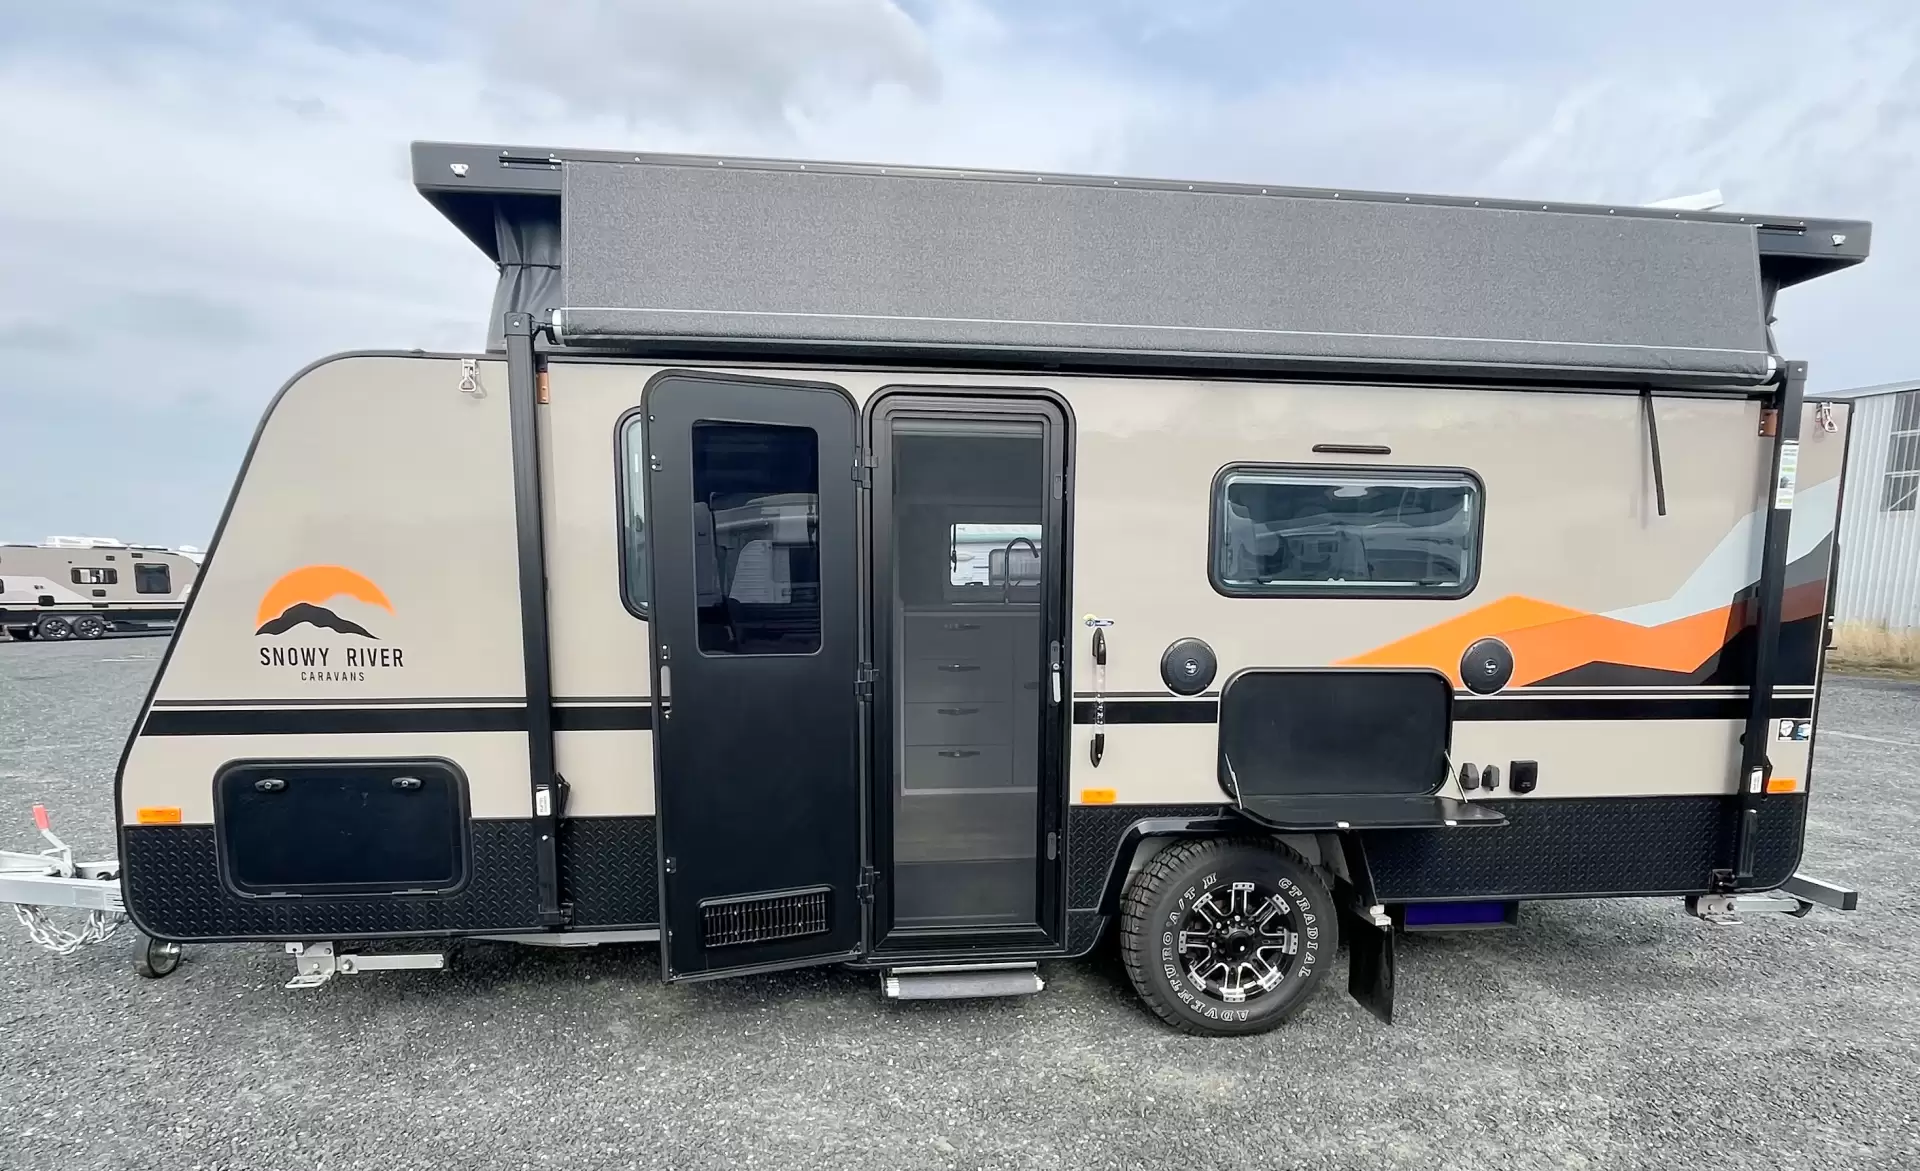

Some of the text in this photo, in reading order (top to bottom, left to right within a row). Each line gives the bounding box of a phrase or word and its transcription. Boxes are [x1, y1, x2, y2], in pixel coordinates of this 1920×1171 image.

[260, 647, 404, 668] SNOWY RIVER
[301, 671, 365, 682] CARAVANS
[1161, 931, 1250, 1022] ADVENTURO
